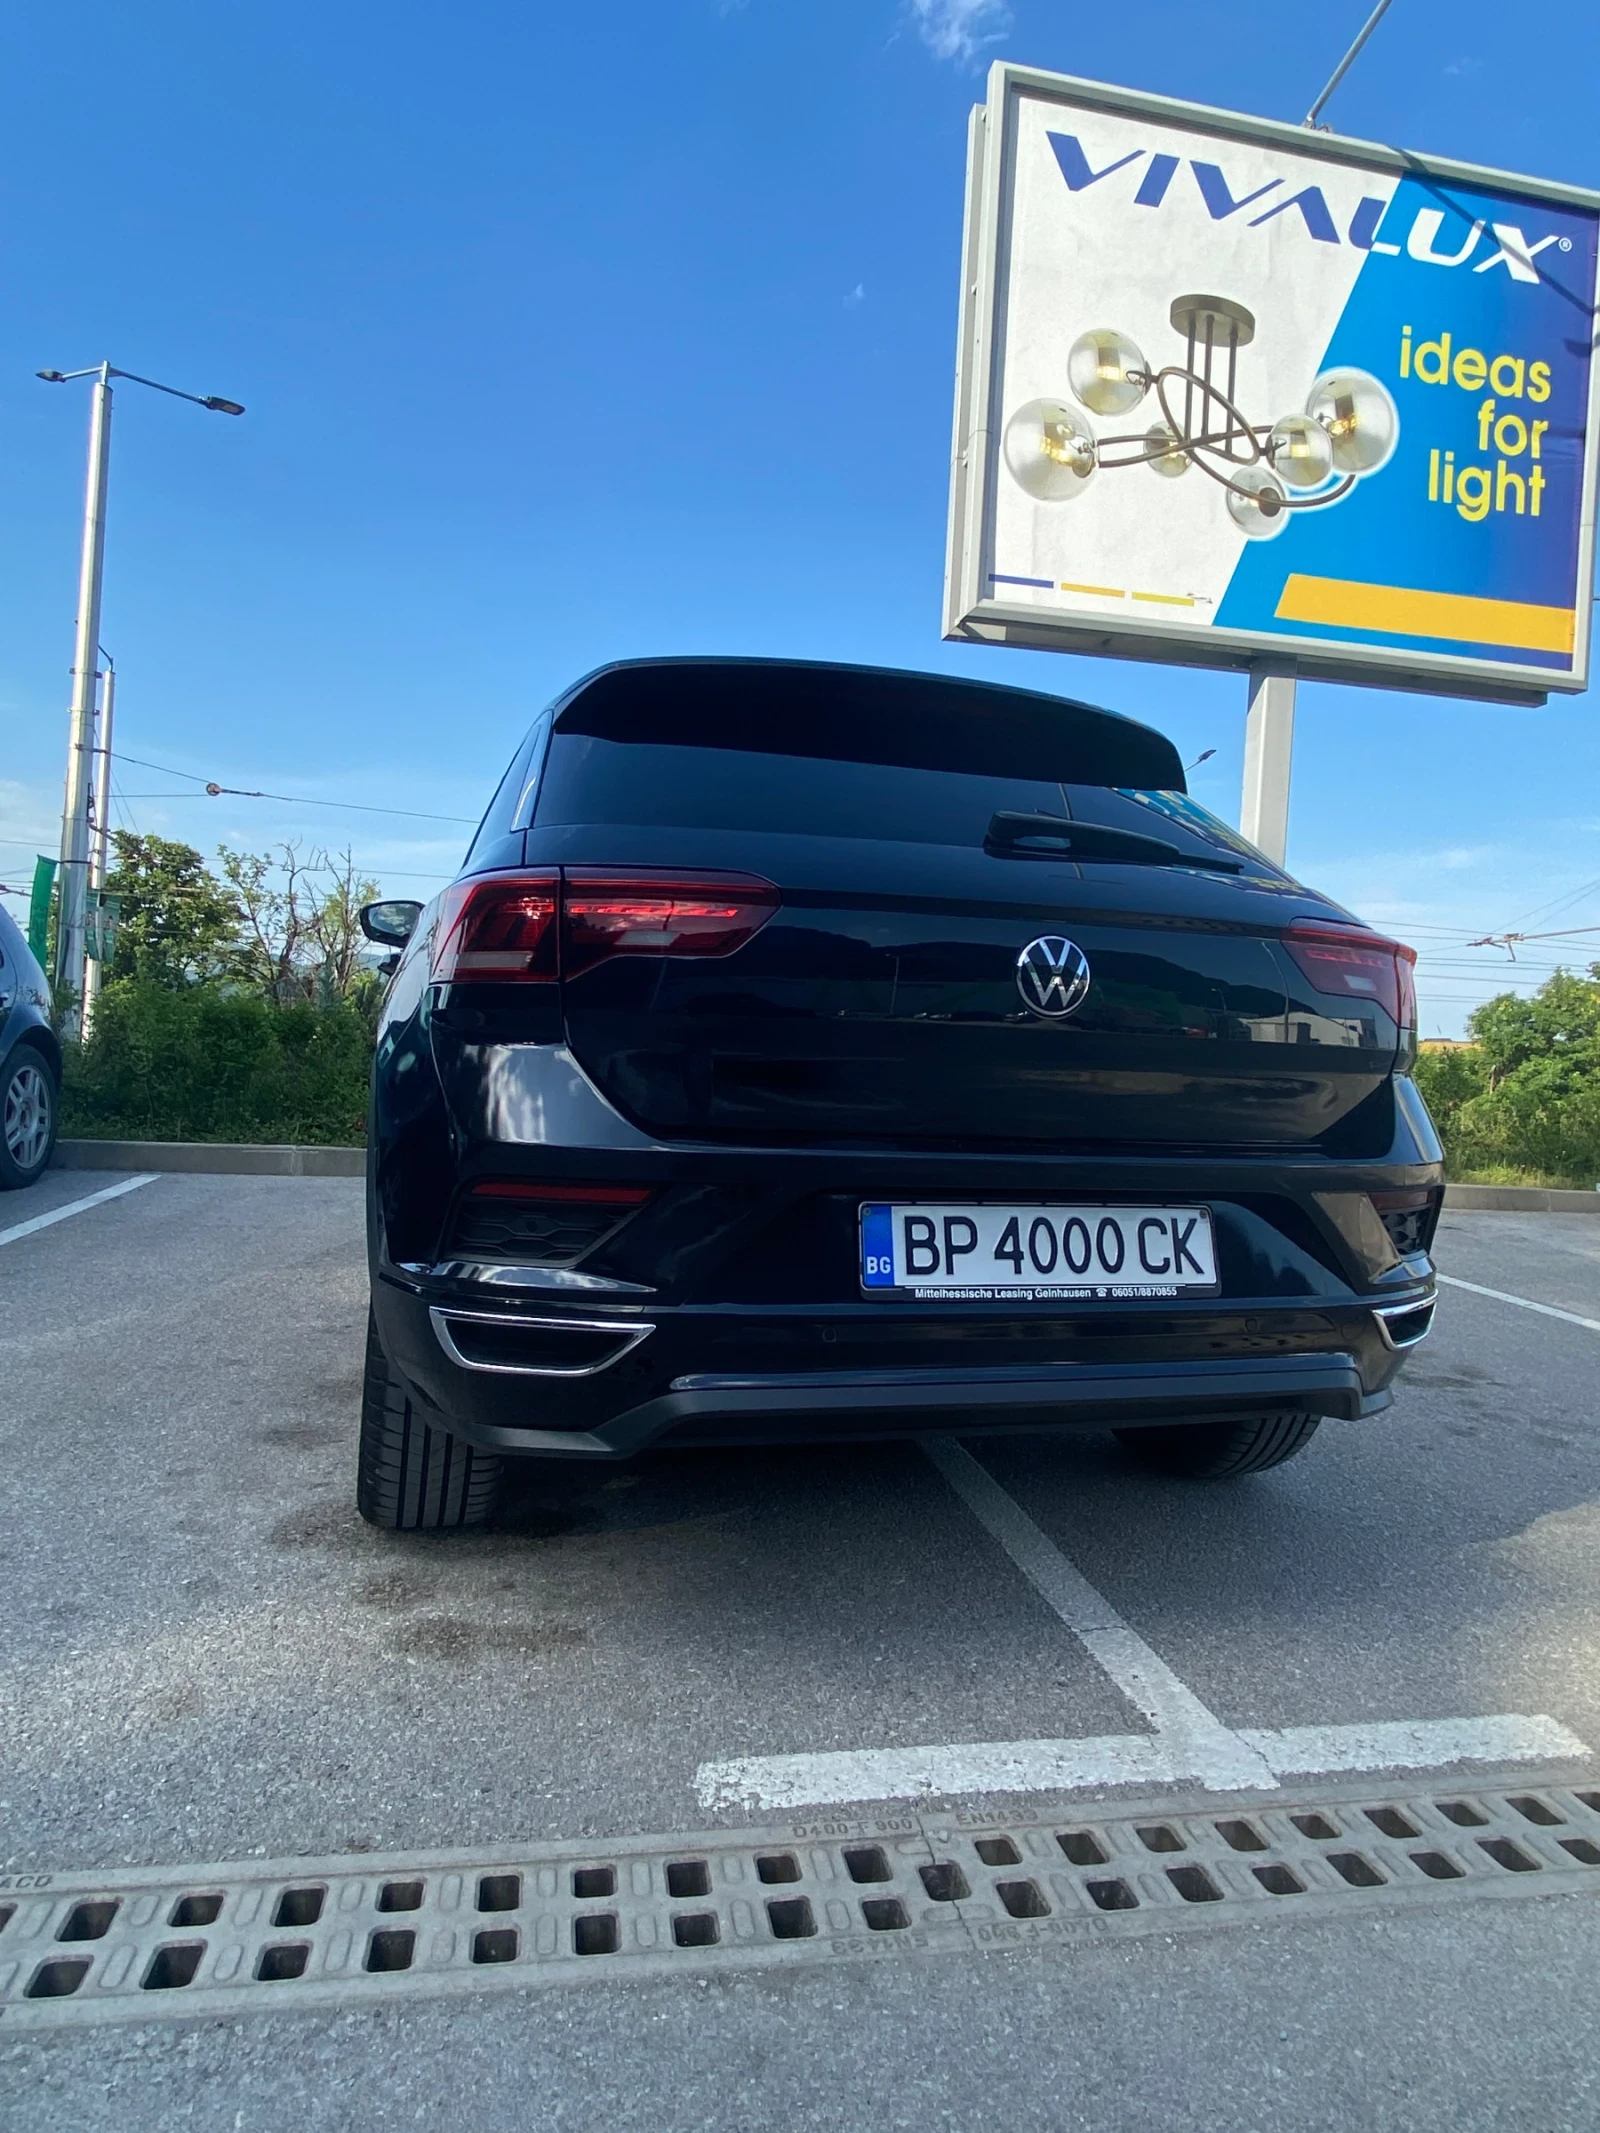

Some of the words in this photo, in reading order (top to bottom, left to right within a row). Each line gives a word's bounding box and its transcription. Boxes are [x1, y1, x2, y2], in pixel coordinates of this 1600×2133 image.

[1045, 131, 1559, 284] VIVALUX
[1400, 325, 1550, 402] ideas
[1478, 399, 1549, 458] for
[1429, 448, 1545, 522] light
[866, 1256, 891, 1274] BG
[904, 1215, 978, 1275] BP
[994, 1216, 1125, 1275] 4000
[1137, 1217, 1205, 1275] CK
[915, 1287, 993, 1299] Mittelhessische
[995, 1287, 1033, 1301] Leasing
[956, 1808, 1038, 1825] EN1433
